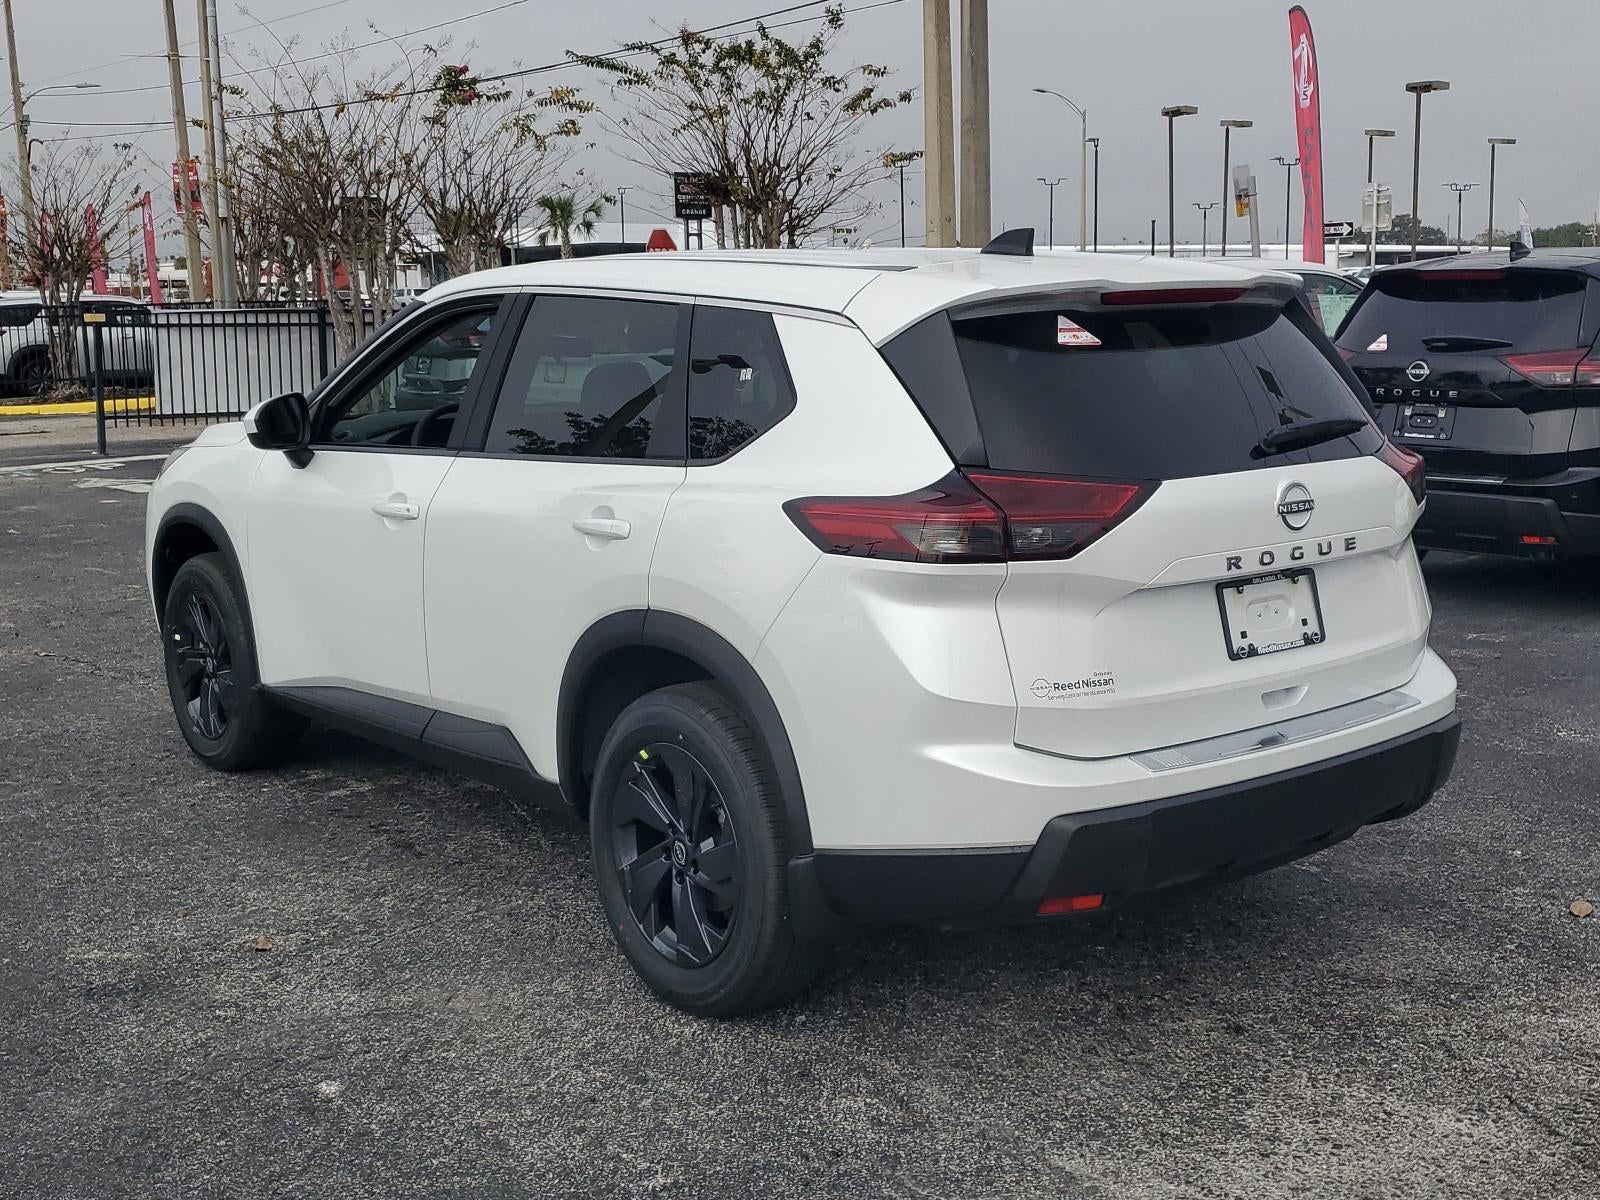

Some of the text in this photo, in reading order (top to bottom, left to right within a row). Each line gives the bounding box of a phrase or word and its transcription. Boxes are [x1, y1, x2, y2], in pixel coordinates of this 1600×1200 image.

[1376, 388, 1459, 398] ROGUE
[1279, 501, 1315, 513] NISSAN
[1226, 537, 1357, 571] ROGUE
